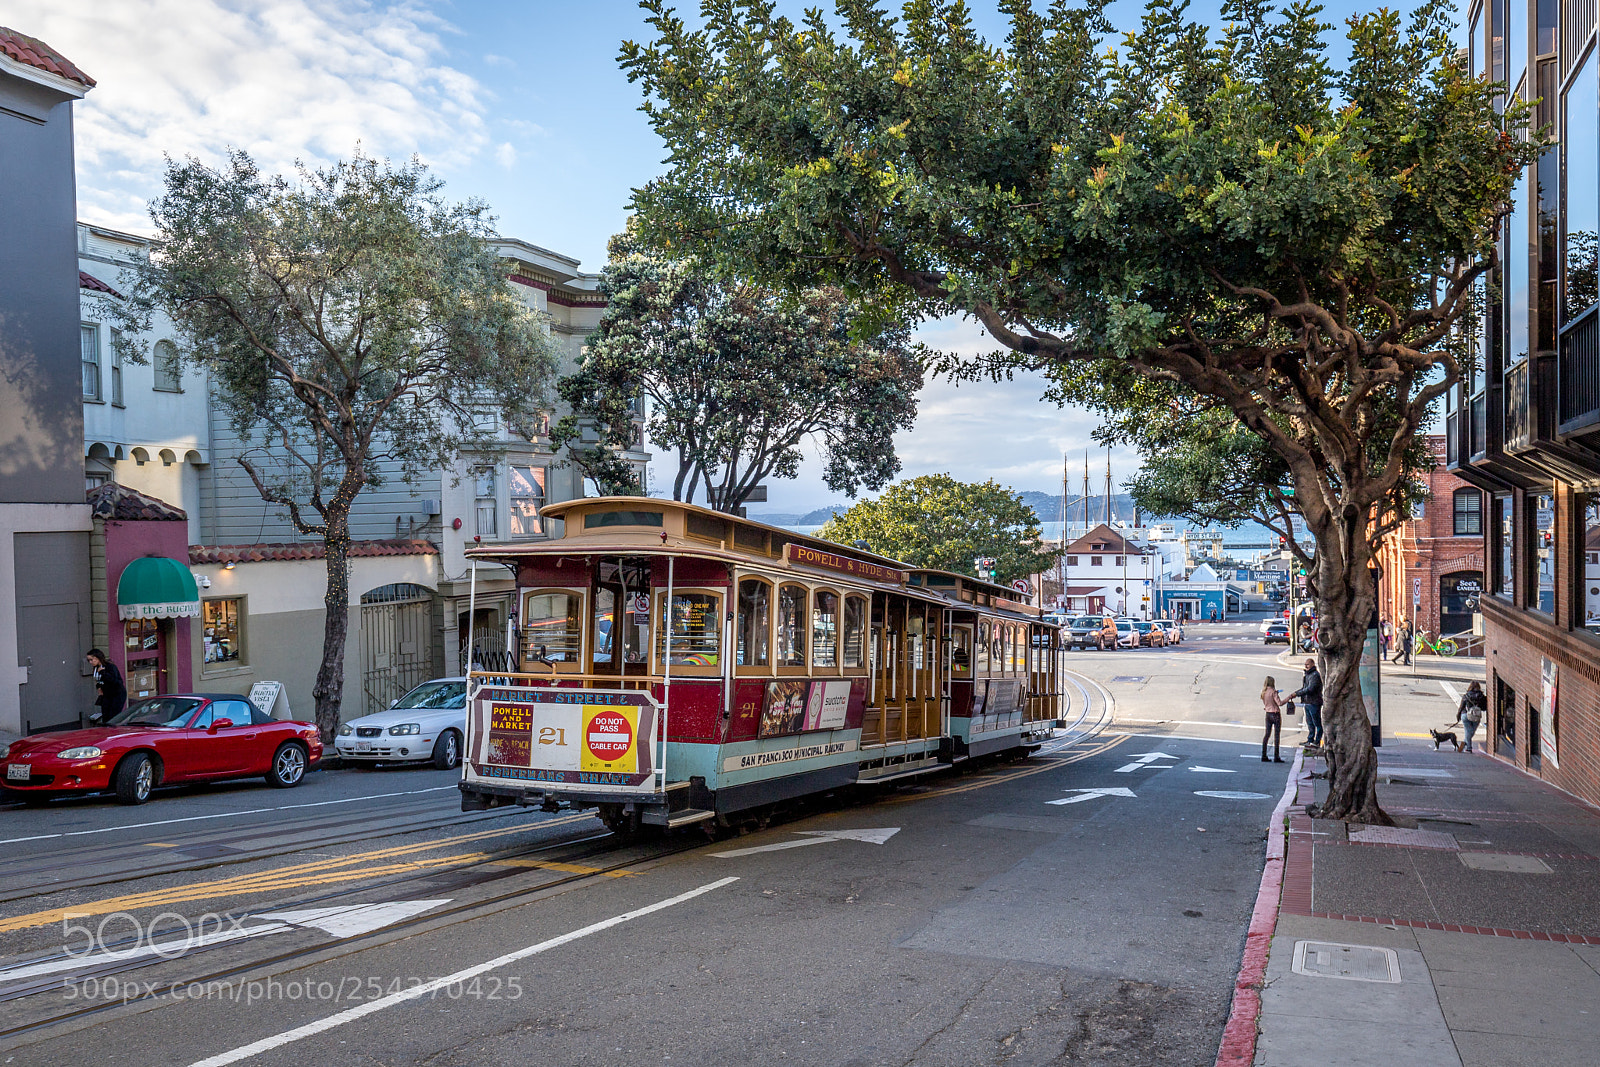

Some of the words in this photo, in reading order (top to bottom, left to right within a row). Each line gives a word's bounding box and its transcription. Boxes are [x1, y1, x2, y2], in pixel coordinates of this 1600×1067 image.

[798, 548, 842, 568] POWELL
[847, 560, 854, 571] &
[858, 562, 882, 577] HYDE
[142, 605, 163, 615] the
[144, 636, 157, 647] OPEN
[491, 690, 543, 702] MARKET
[555, 693, 614, 705] STREET
[493, 707, 531, 716] POWELL
[740, 702, 755, 718] 21
[491, 720, 532, 730] MARKET
[595, 717, 606, 725] DO
[607, 718, 624, 726] NOT
[599, 724, 619, 732] PASS
[538, 727, 568, 746] 21
[590, 742, 612, 750] CABLE
[613, 742, 628, 751] CAR
[740, 755, 756, 767] SAN
[793, 745, 823, 760] MUNICIPAL
[824, 742, 846, 755] RAILWAY
[482, 766, 565, 782] FISHERMANS
[579, 772, 631, 785] WHARF
